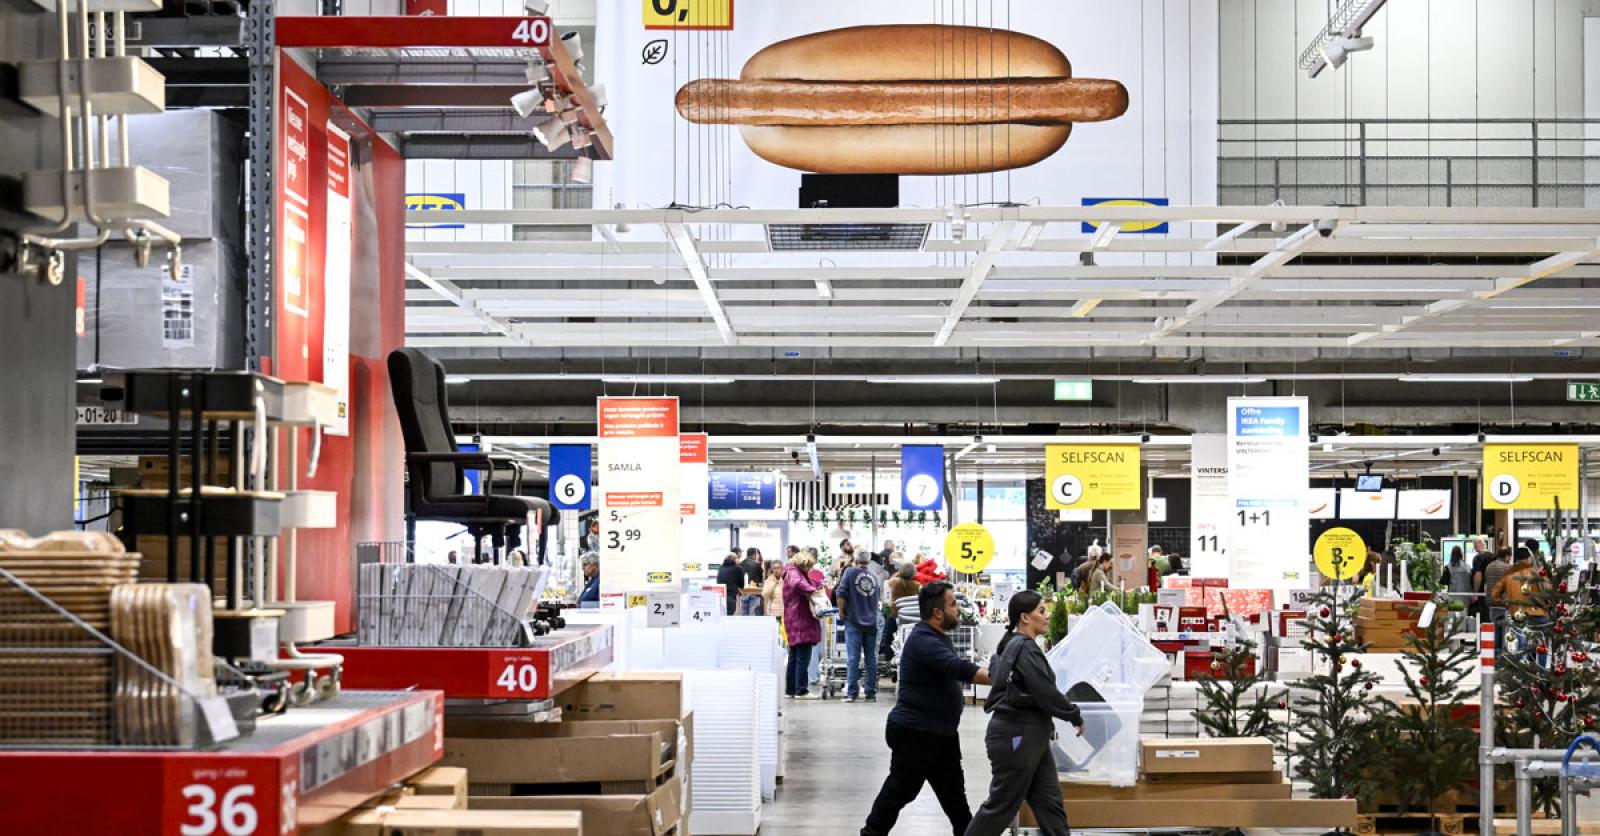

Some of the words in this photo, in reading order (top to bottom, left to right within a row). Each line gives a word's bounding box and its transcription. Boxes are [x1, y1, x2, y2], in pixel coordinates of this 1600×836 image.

[511, 19, 548, 44] 40
[1240, 408, 1262, 416] Offre
[1061, 451, 1125, 463] SELFSCAN
[1499, 451, 1563, 463] SELFSCAN
[608, 463, 642, 472] SAMLA
[564, 482, 575, 497] 6
[918, 484, 927, 497] 7
[1061, 481, 1073, 497] C
[1499, 481, 1512, 496] D
[611, 510, 627, 523] 5,-
[1237, 510, 1270, 526] 1+1
[607, 529, 641, 552] 3,99
[1197, 535, 1226, 555] 11,
[960, 542, 984, 562] 5,-
[653, 603, 674, 616] 2,99
[497, 664, 538, 692] 40
[180, 783, 258, 836] 36
